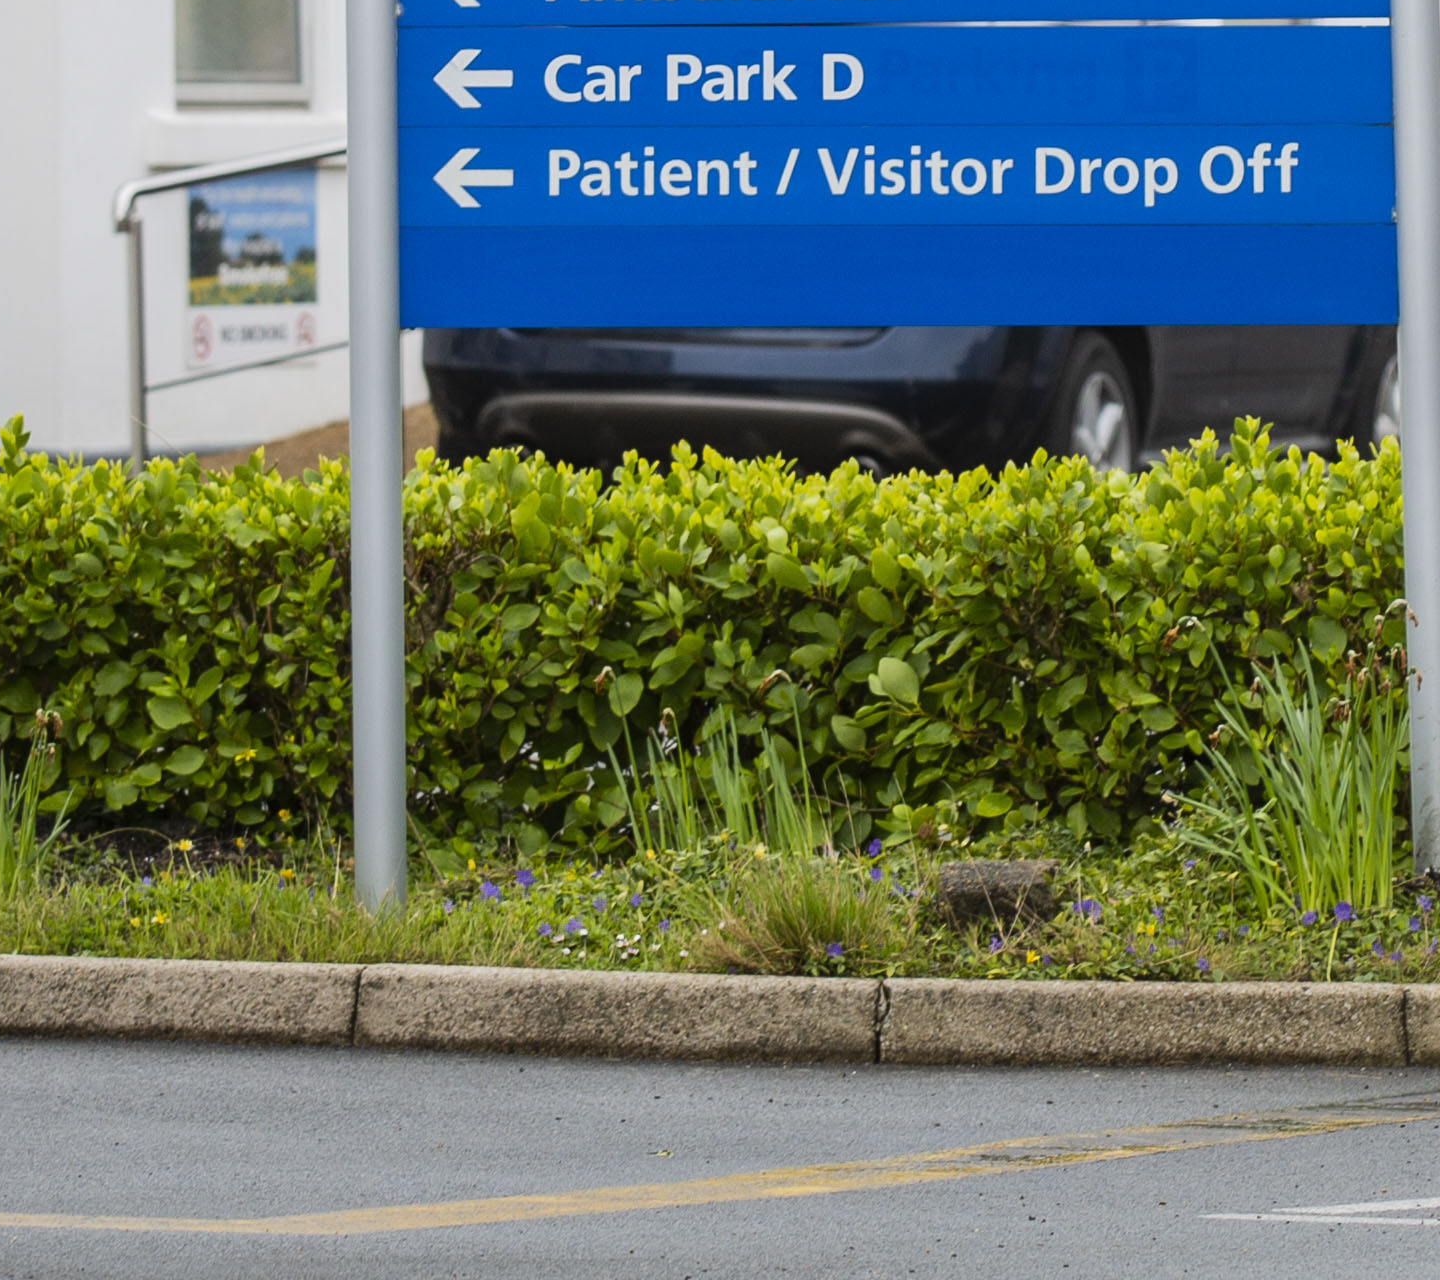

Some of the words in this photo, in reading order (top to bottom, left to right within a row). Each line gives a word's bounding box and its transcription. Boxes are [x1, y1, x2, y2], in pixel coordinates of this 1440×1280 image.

[544, 54, 642, 103] Car
[666, 50, 798, 102] Park
[822, 53, 864, 101] D
[549, 146, 758, 197] Patient
[776, 148, 800, 195] /
[817, 145, 1014, 195] Visitor
[1035, 147, 1178, 207] Drop
[1199, 142, 1299, 194] Off
